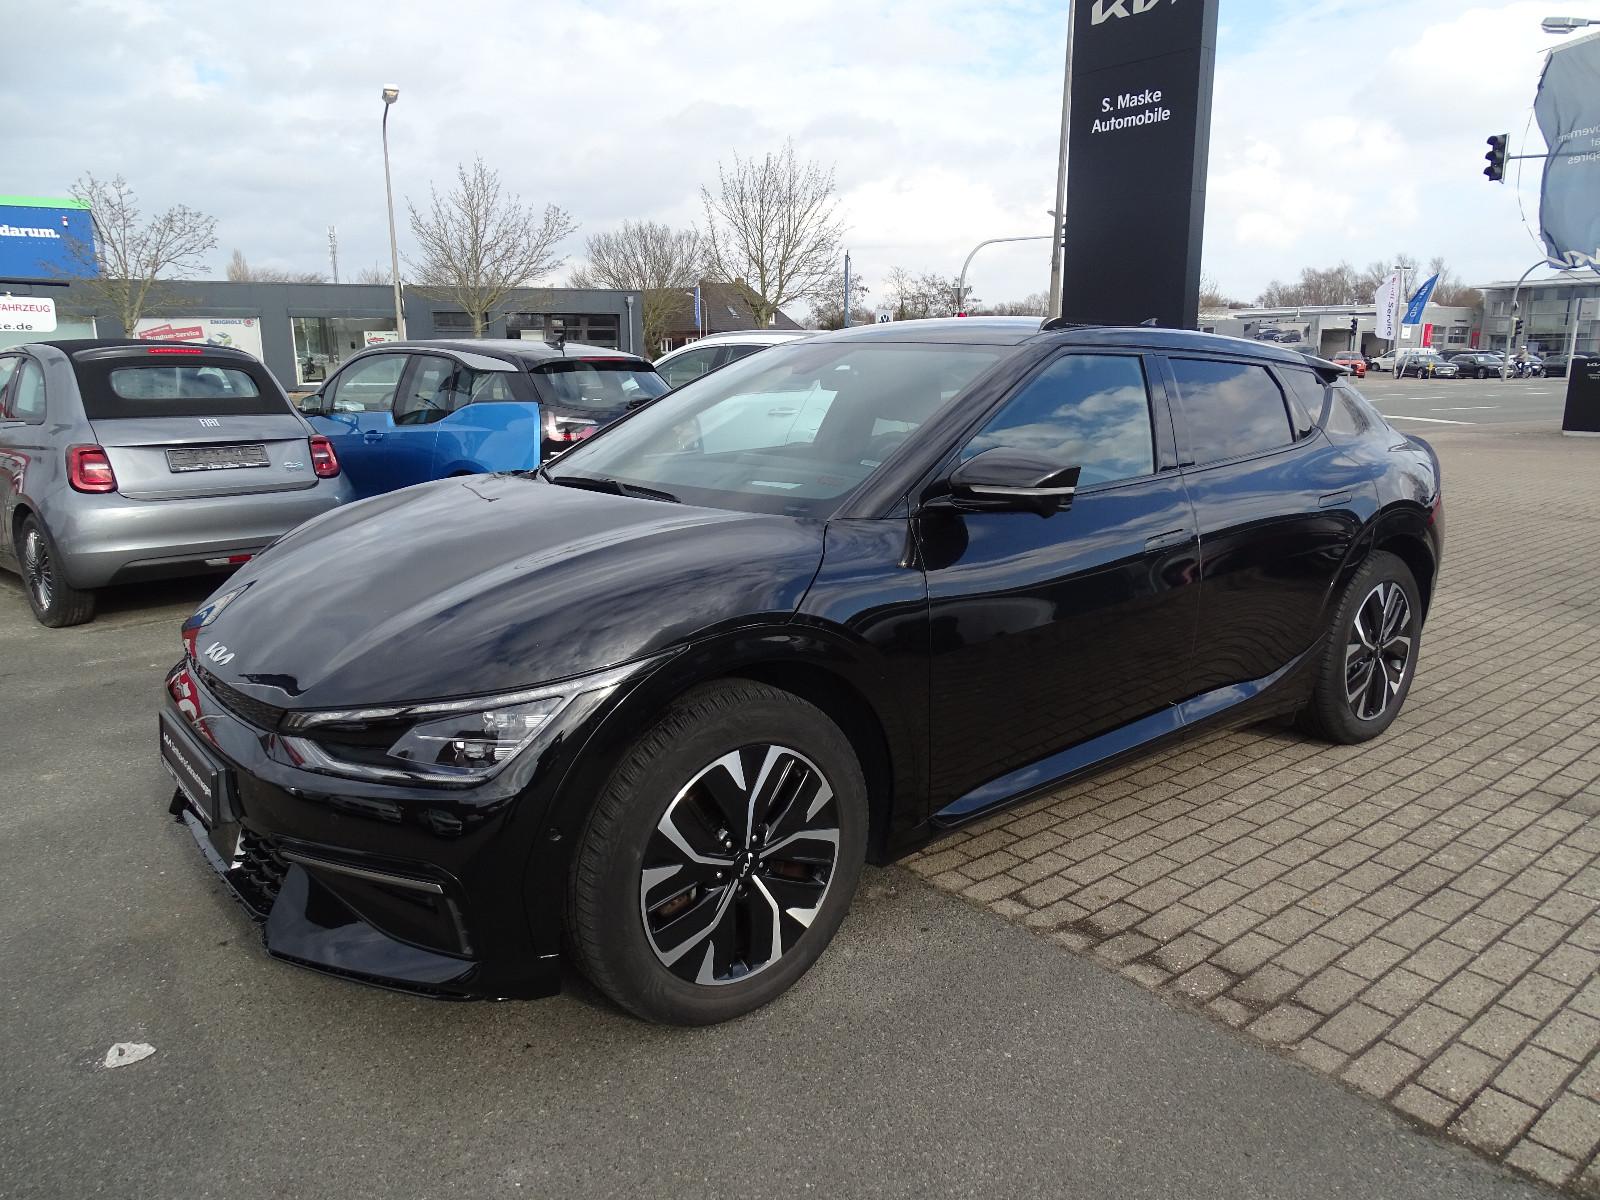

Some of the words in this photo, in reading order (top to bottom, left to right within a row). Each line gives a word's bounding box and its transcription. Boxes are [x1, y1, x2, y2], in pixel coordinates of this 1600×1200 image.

[1101, 97, 1114, 113] S.
[1117, 89, 1162, 111] Maske
[1091, 107, 1171, 134] Automobile
[0, 224, 60, 239] darum.
[199, 418, 220, 428] FIAT
[204, 641, 235, 666] KIA
